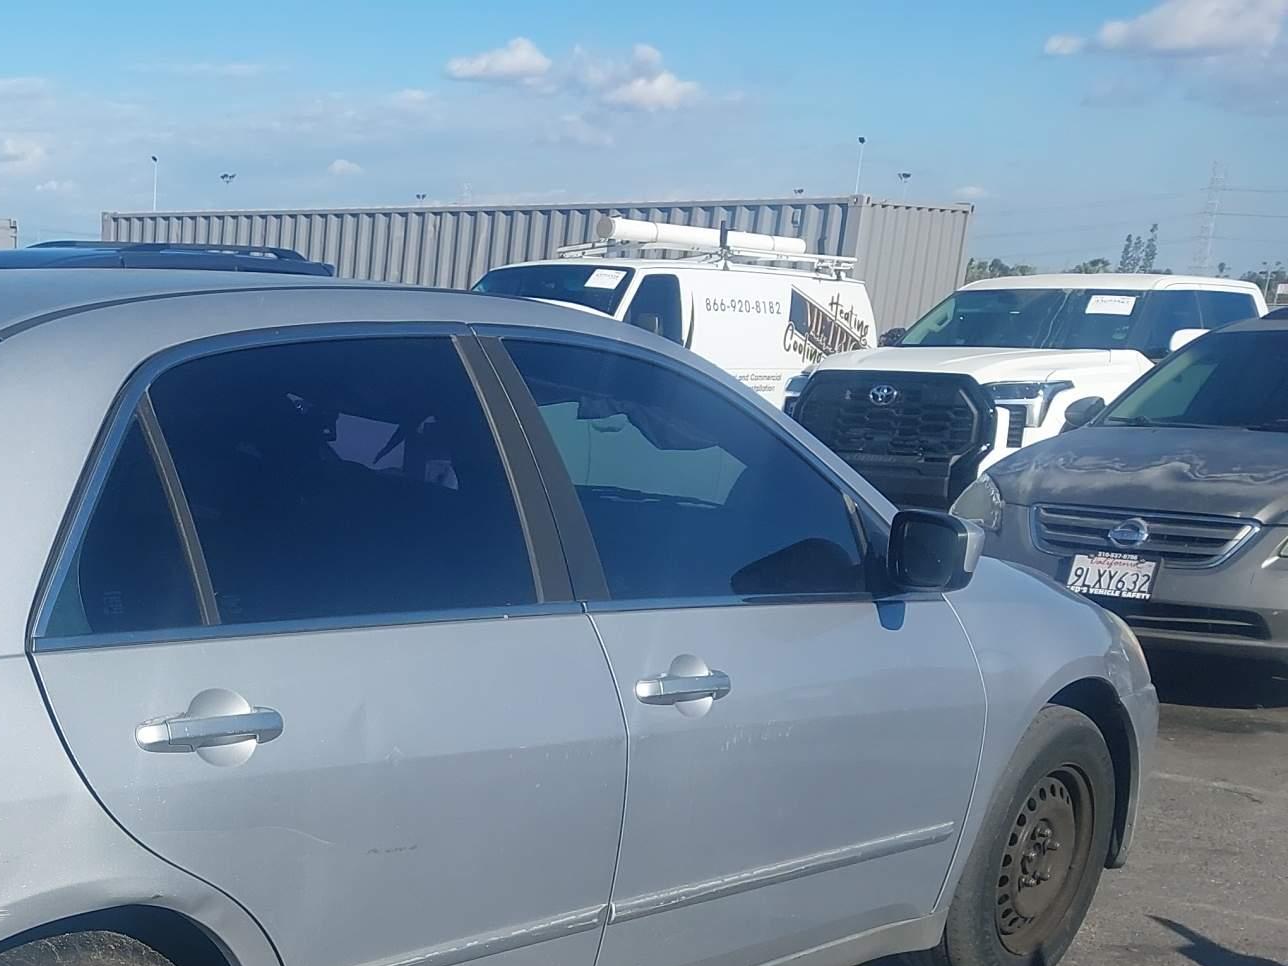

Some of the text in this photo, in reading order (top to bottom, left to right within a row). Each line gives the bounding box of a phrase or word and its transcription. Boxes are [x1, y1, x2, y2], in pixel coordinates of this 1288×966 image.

[705, 297, 782, 315] 866-920-8182
[828, 292, 870, 346] Heating
[1070, 566, 1151, 593] 9LXY632
[1089, 587, 1120, 597] VEHICLE
[1121, 591, 1151, 600] SAFETY
